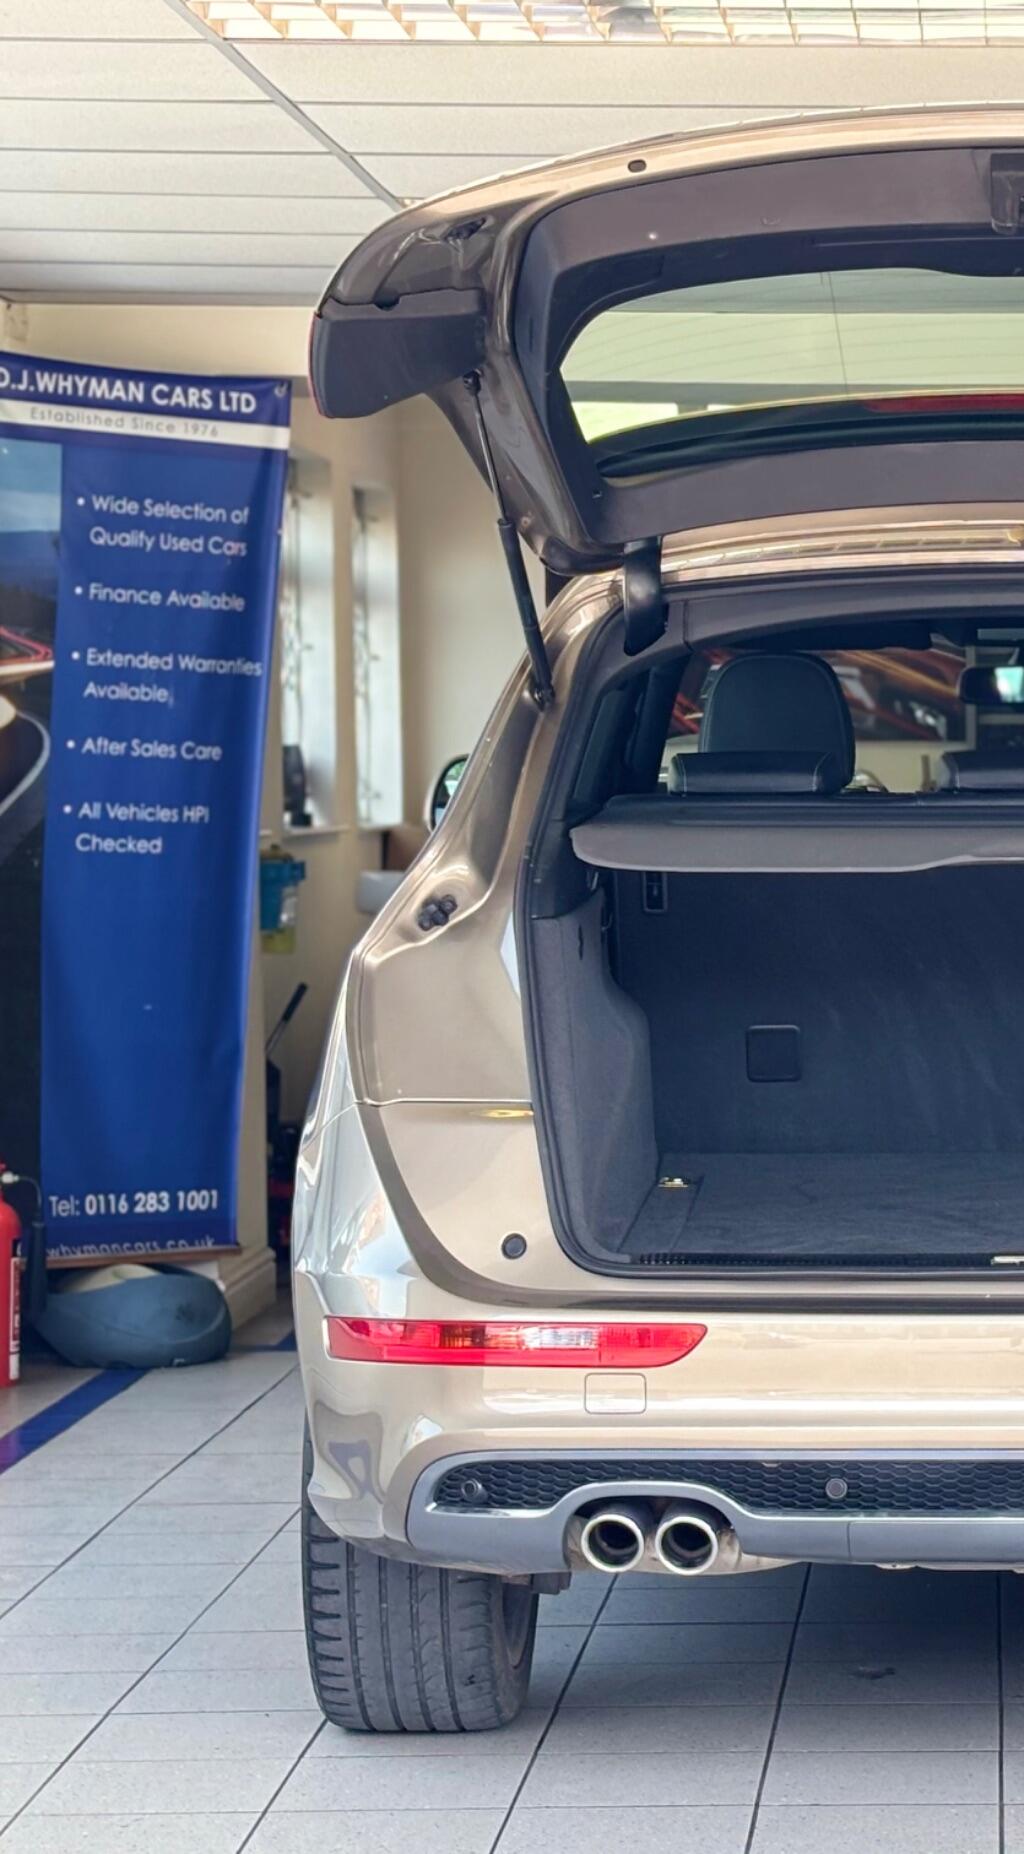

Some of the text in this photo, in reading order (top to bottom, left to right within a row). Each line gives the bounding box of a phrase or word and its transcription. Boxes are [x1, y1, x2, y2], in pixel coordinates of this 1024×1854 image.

[151, 383, 213, 410] CARS
[220, 391, 257, 413] LTD
[30, 406, 219, 438] Established Since 1976
[91, 495, 249, 524] Wide Selection of
[89, 526, 247, 556] Quality Used Cars
[89, 582, 246, 612] Finance Available
[86, 647, 262, 677] Extended Warranties
[82, 736, 223, 761] After Sales Care
[78, 802, 209, 823] All Vehicles HPI
[75, 832, 163, 854] Checked
[49, 1189, 218, 1217] Tel: 0116 283 1001
[46, 1235, 215, 1258] whymancarscouk
